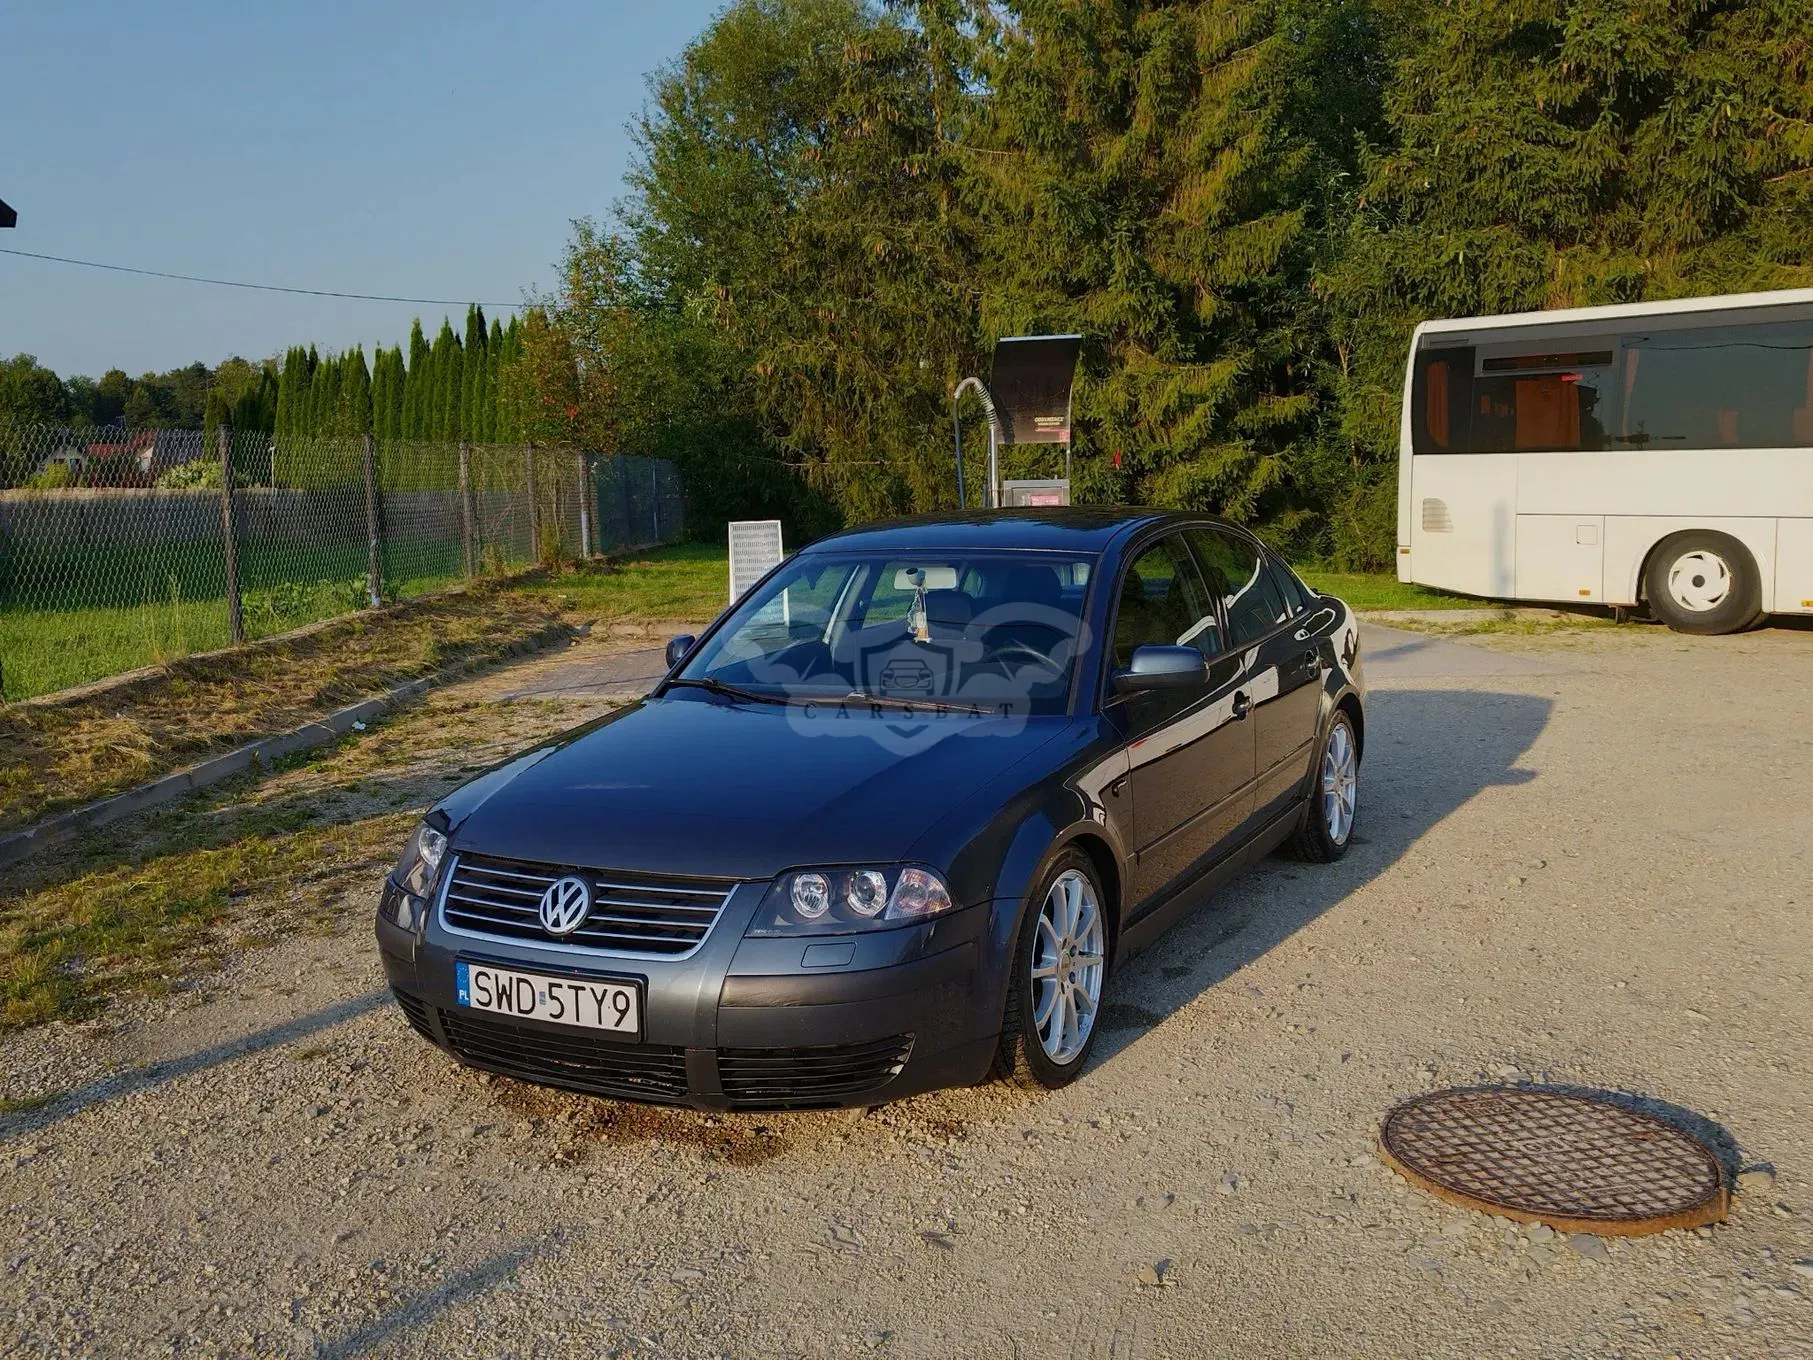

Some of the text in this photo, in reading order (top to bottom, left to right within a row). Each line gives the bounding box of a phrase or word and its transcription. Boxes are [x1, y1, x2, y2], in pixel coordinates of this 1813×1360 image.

[458, 989, 469, 1001] PL
[474, 970, 631, 1028] SWD 5TY9
